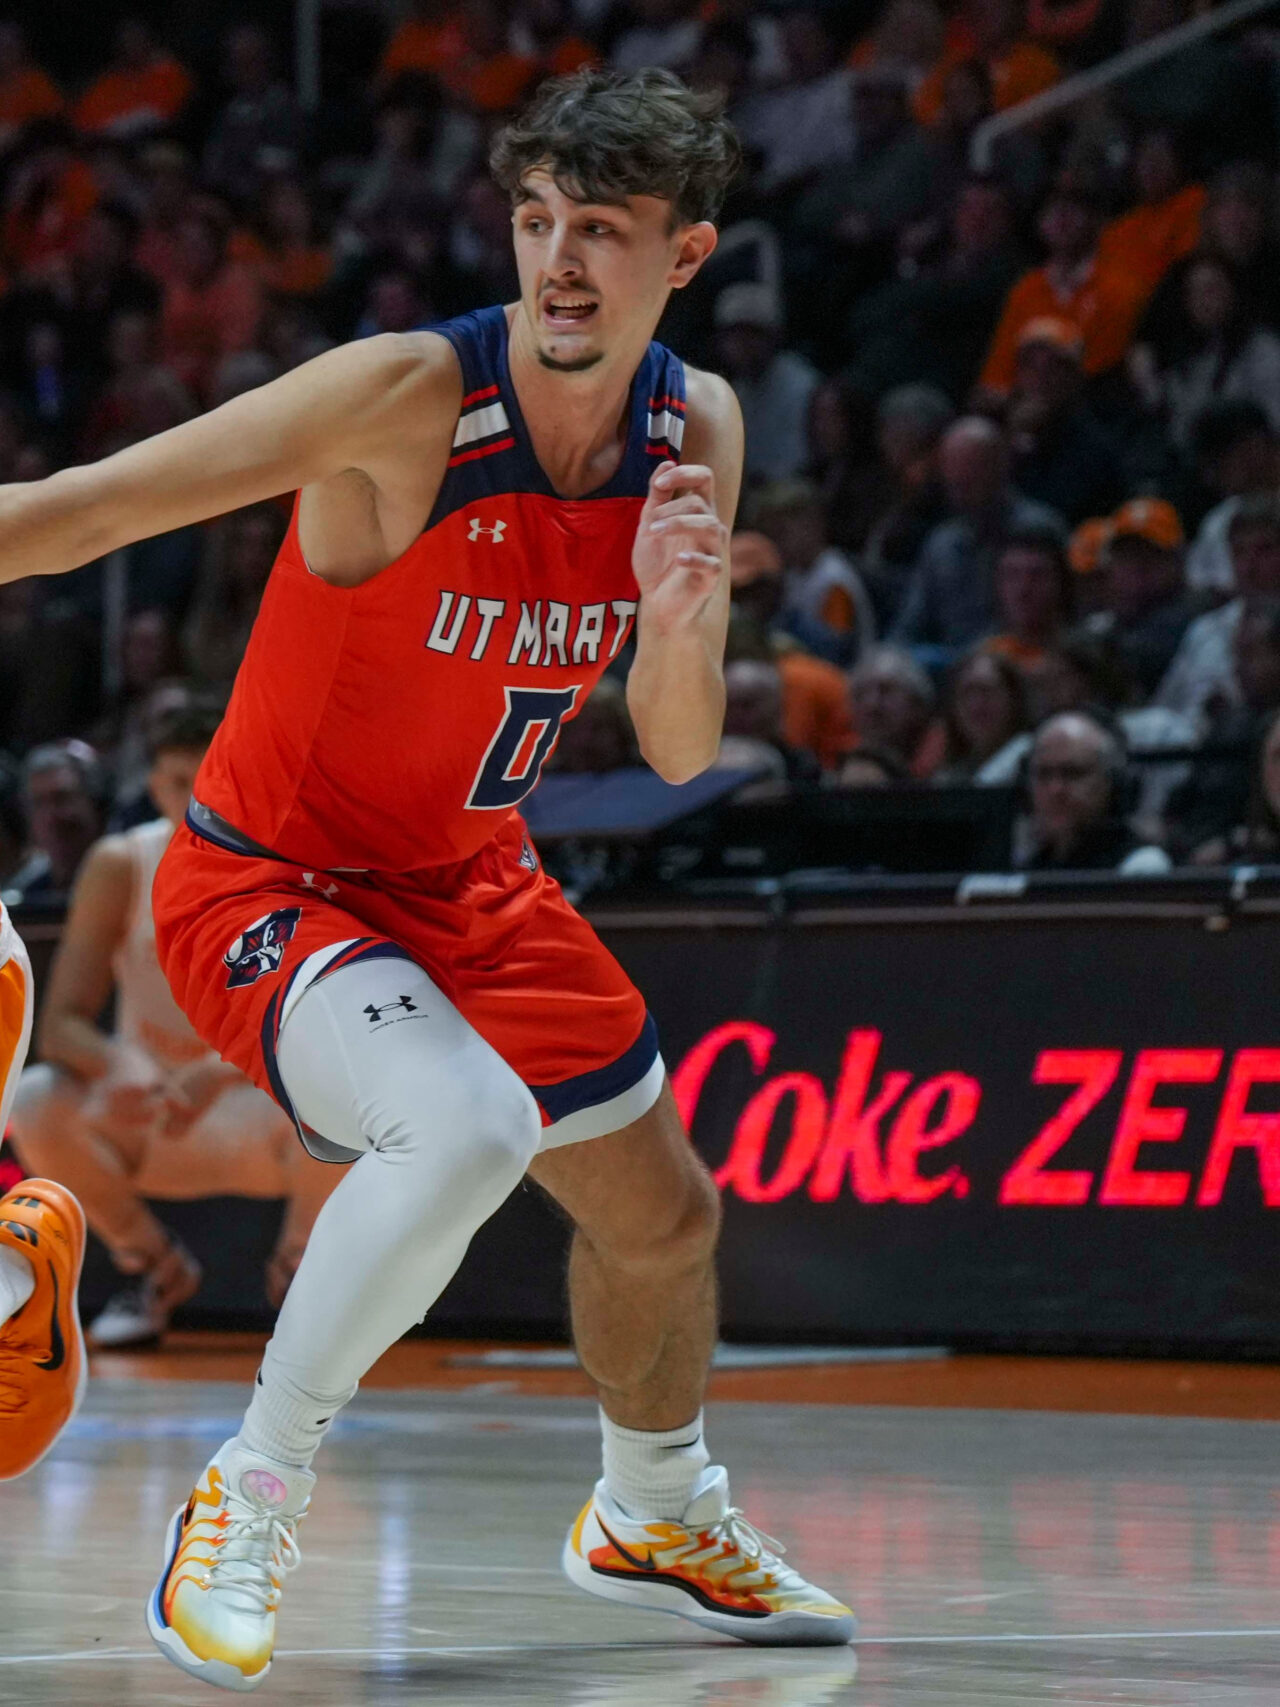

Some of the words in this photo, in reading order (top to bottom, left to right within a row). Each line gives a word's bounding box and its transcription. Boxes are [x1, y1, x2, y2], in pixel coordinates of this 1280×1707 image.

[425, 590, 506, 661] UT
[670, 1020, 982, 1204] Coke
[998, 1047, 1280, 1207] ZER
